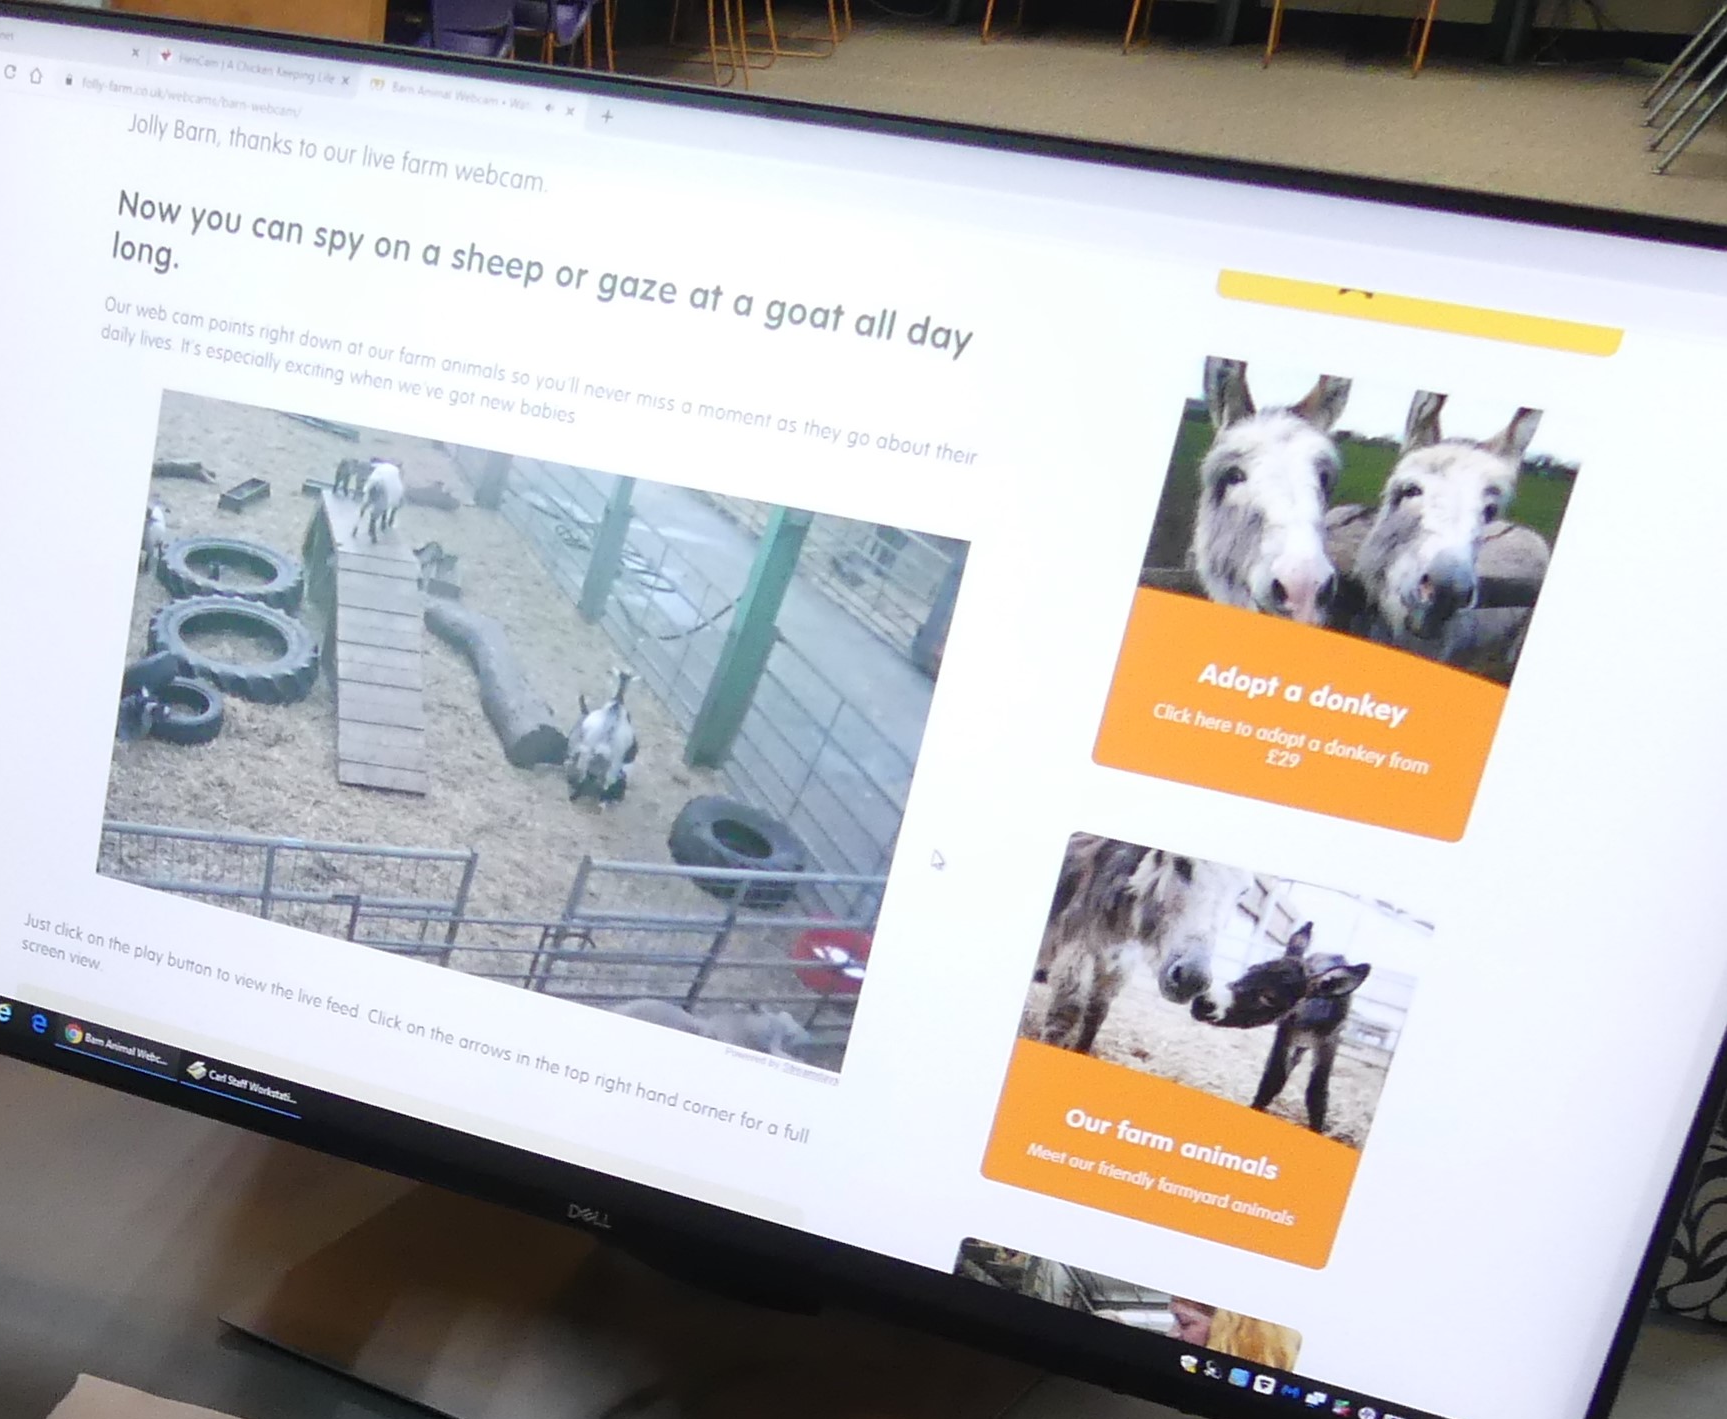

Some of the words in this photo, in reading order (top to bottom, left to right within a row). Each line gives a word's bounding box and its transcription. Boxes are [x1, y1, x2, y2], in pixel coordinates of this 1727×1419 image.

[127, 113, 169, 142] Jolly
[173, 119, 221, 148] Barn,
[229, 126, 293, 155] thanks
[299, 138, 317, 159] to
[323, 145, 357, 164] our
[362, 144, 395, 170] live
[402, 150, 448, 178] farm
[455, 162, 548, 192] webcam.
[113, 230, 178, 275] long.
[118, 189, 182, 224] Now
[191, 206, 242, 236] you
[252, 217, 303, 245] can
[313, 227, 365, 261] spy
[374, 237, 410, 262] on
[422, 244, 441, 266] a
[451, 242, 544, 288] sheep
[556, 266, 589, 289] or
[597, 273, 677, 304] gaze
[689, 285, 723, 312] at
[733, 294, 753, 317] a
[764, 300, 845, 332] goat
[855, 308, 897, 340] all
[907, 315, 973, 361] day
[101, 323, 136, 347] daily
[140, 329, 176, 351] lives.
[205, 346, 281, 373] especially
[285, 360, 344, 386] exciting
[350, 369, 393, 390] when
[449, 390, 475, 406] got
[480, 395, 515, 412] new
[520, 398, 575, 424] babies
[105, 295, 132, 315] Our
[136, 304, 167, 322] web
[172, 311, 204, 328] cam
[208, 318, 255, 337] points
[259, 325, 295, 345] right
[299, 329, 342, 352] down
[347, 342, 363, 355] at
[368, 346, 395, 360] our
[399, 346, 436, 368] farm
[441, 359, 505, 381] animals
[511, 371, 530, 385] so
[584, 384, 632, 402] never
[636, 393, 675, 411] miss
[681, 401, 692, 414] a
[698, 404, 772, 427] moment
[777, 418, 797, 433] as
[804, 419, 842, 444] they
[847, 431, 870, 448] go
[876, 433, 931, 457] about
[936, 442, 978, 465] their
[1197, 663, 1280, 699] Adopt
[1284, 685, 1303, 702] a
[1309, 685, 1409, 728] donkey
[1153, 703, 1192, 724] Click
[1194, 710, 1232, 733] here
[1234, 721, 1253, 737] to
[1255, 727, 1306, 749] adopt
[1307, 739, 1321, 752] a
[1324, 739, 1387, 768] donkey
[1388, 751, 1430, 775] from
[1265, 748, 1301, 768] £29
[21, 939, 66, 960] screen
[69, 953, 104, 970] view.
[24, 913, 51, 932] Just
[54, 922, 83, 942] click
[87, 933, 104, 947] on
[109, 936, 130, 954] the
[134, 945, 164, 966] play
[167, 951, 212, 977] button
[217, 968, 230, 982] to
[234, 974, 267, 992] view
[271, 982, 294, 1000] the
[298, 988, 322, 1008] live
[326, 996, 365, 1018] feed.
[368, 1009, 402, 1031] Click
[406, 1023, 425, 1037] on
[430, 1026, 454, 1045] the
[459, 1037, 512, 1061] arrows
[516, 1053, 530, 1066] in
[535, 1055, 560, 1074] the
[564, 1065, 590, 1084] top
[595, 1075, 632, 1094] right
[635, 1082, 679, 1107] hand
[682, 1100, 736, 1123] corner
[740, 1111, 763, 1130] for
[767, 1123, 779, 1135] a
[784, 1123, 810, 1144] full
[1065, 1109, 1113, 1135] Our
[1117, 1120, 1174, 1152] farm
[1180, 1142, 1278, 1180] animals
[567, 1203, 611, 1229] DELL
[1026, 1142, 1067, 1164] Meet
[1068, 1157, 1096, 1172] our
[1097, 1160, 1155, 1190] friendly
[1157, 1176, 1230, 1208] farmyard
[1231, 1200, 1295, 1226] animals
